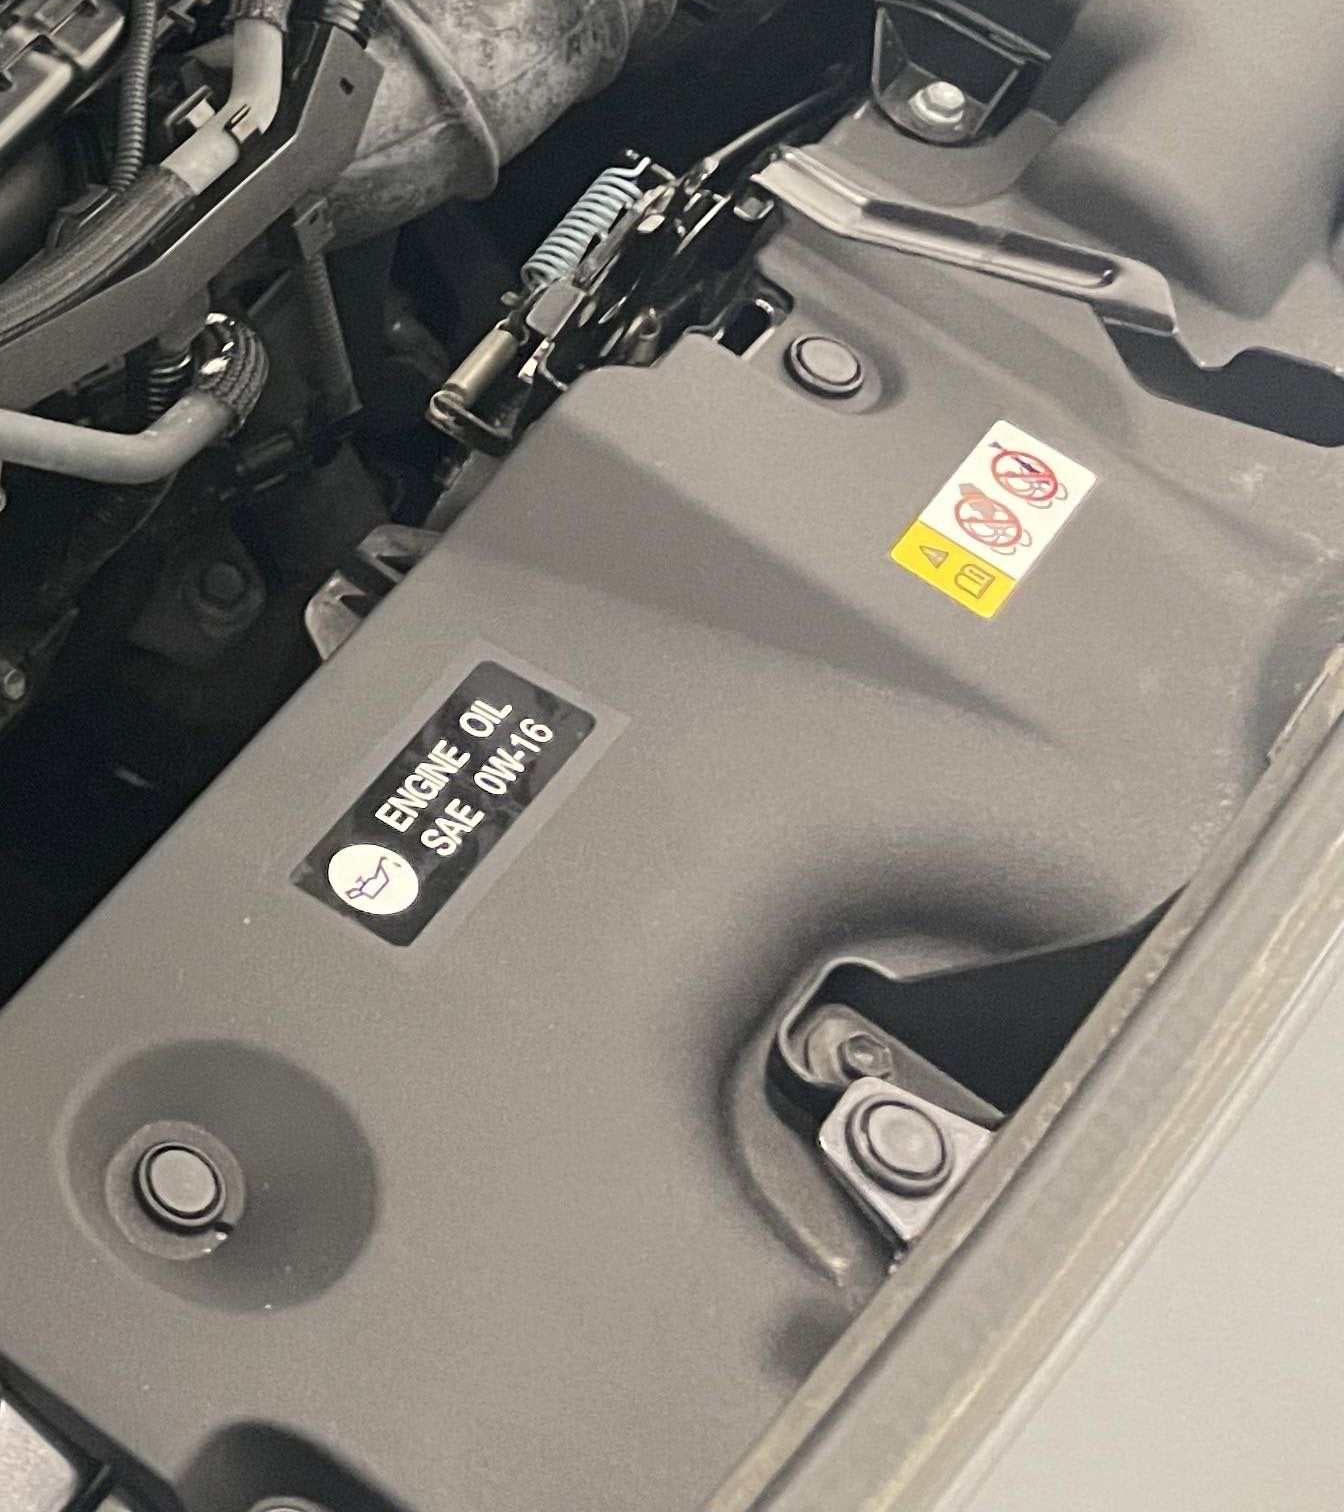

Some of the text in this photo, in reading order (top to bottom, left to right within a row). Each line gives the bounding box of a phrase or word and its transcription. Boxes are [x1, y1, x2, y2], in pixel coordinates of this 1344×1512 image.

[374, 698, 514, 834] ENGINE OIL
[420, 717, 555, 858] SAE 0W-16
